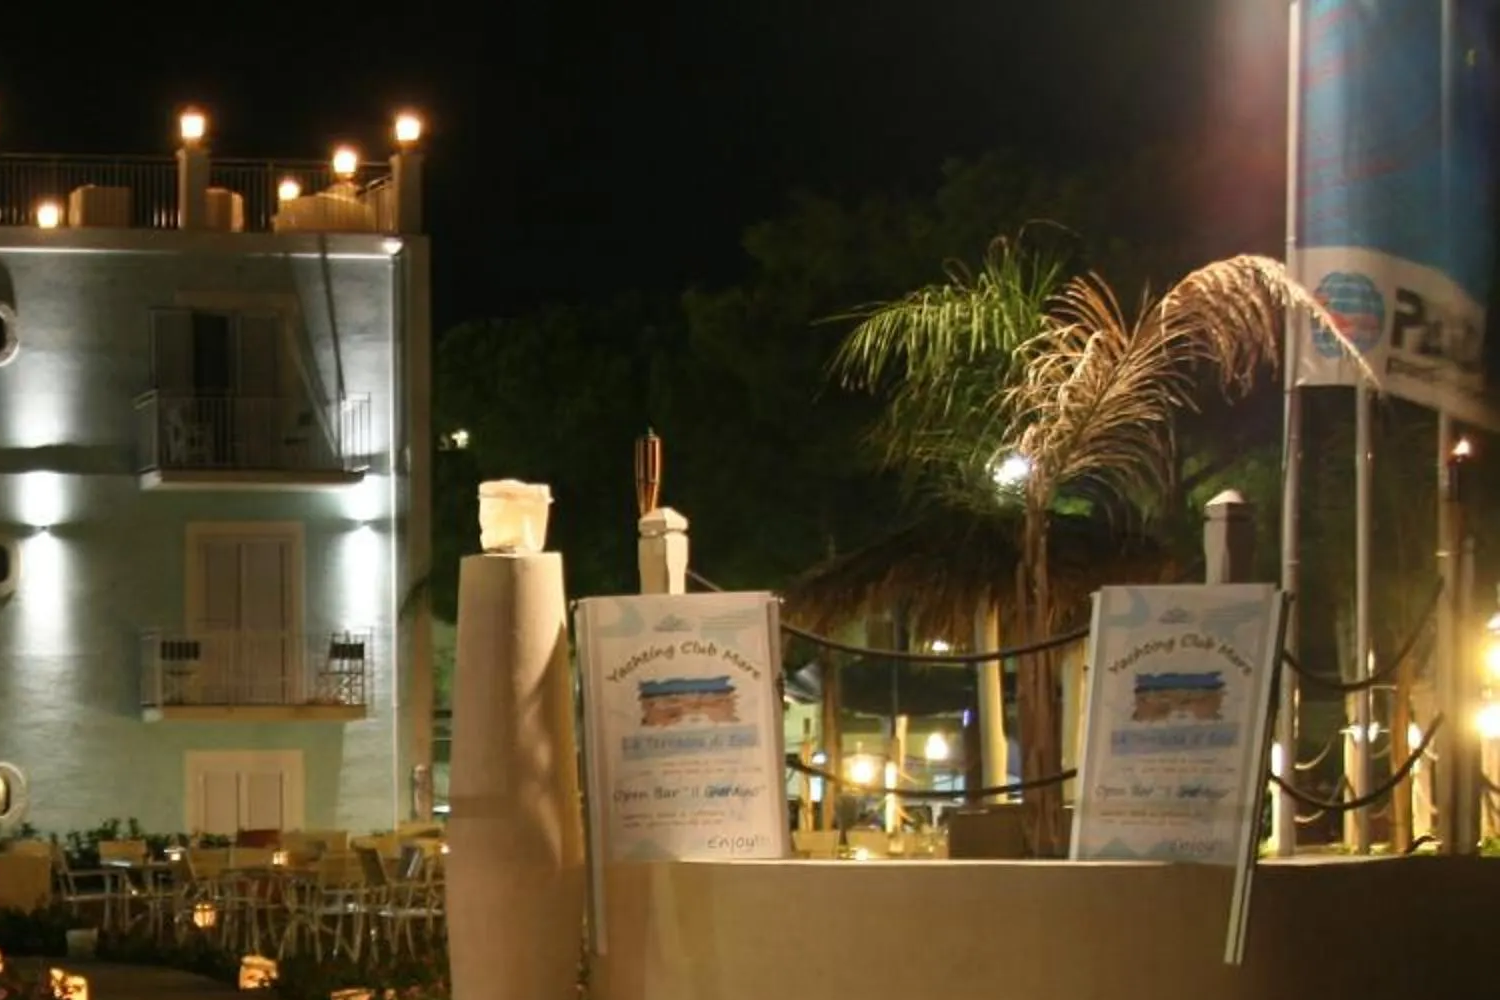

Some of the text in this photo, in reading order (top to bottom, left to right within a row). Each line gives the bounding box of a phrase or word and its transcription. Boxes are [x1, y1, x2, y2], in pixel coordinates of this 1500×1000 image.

[605, 641, 762, 683] Yachting Club Mare
[1108, 637, 1176, 674] Yachting
[1181, 633, 1216, 650] Club
